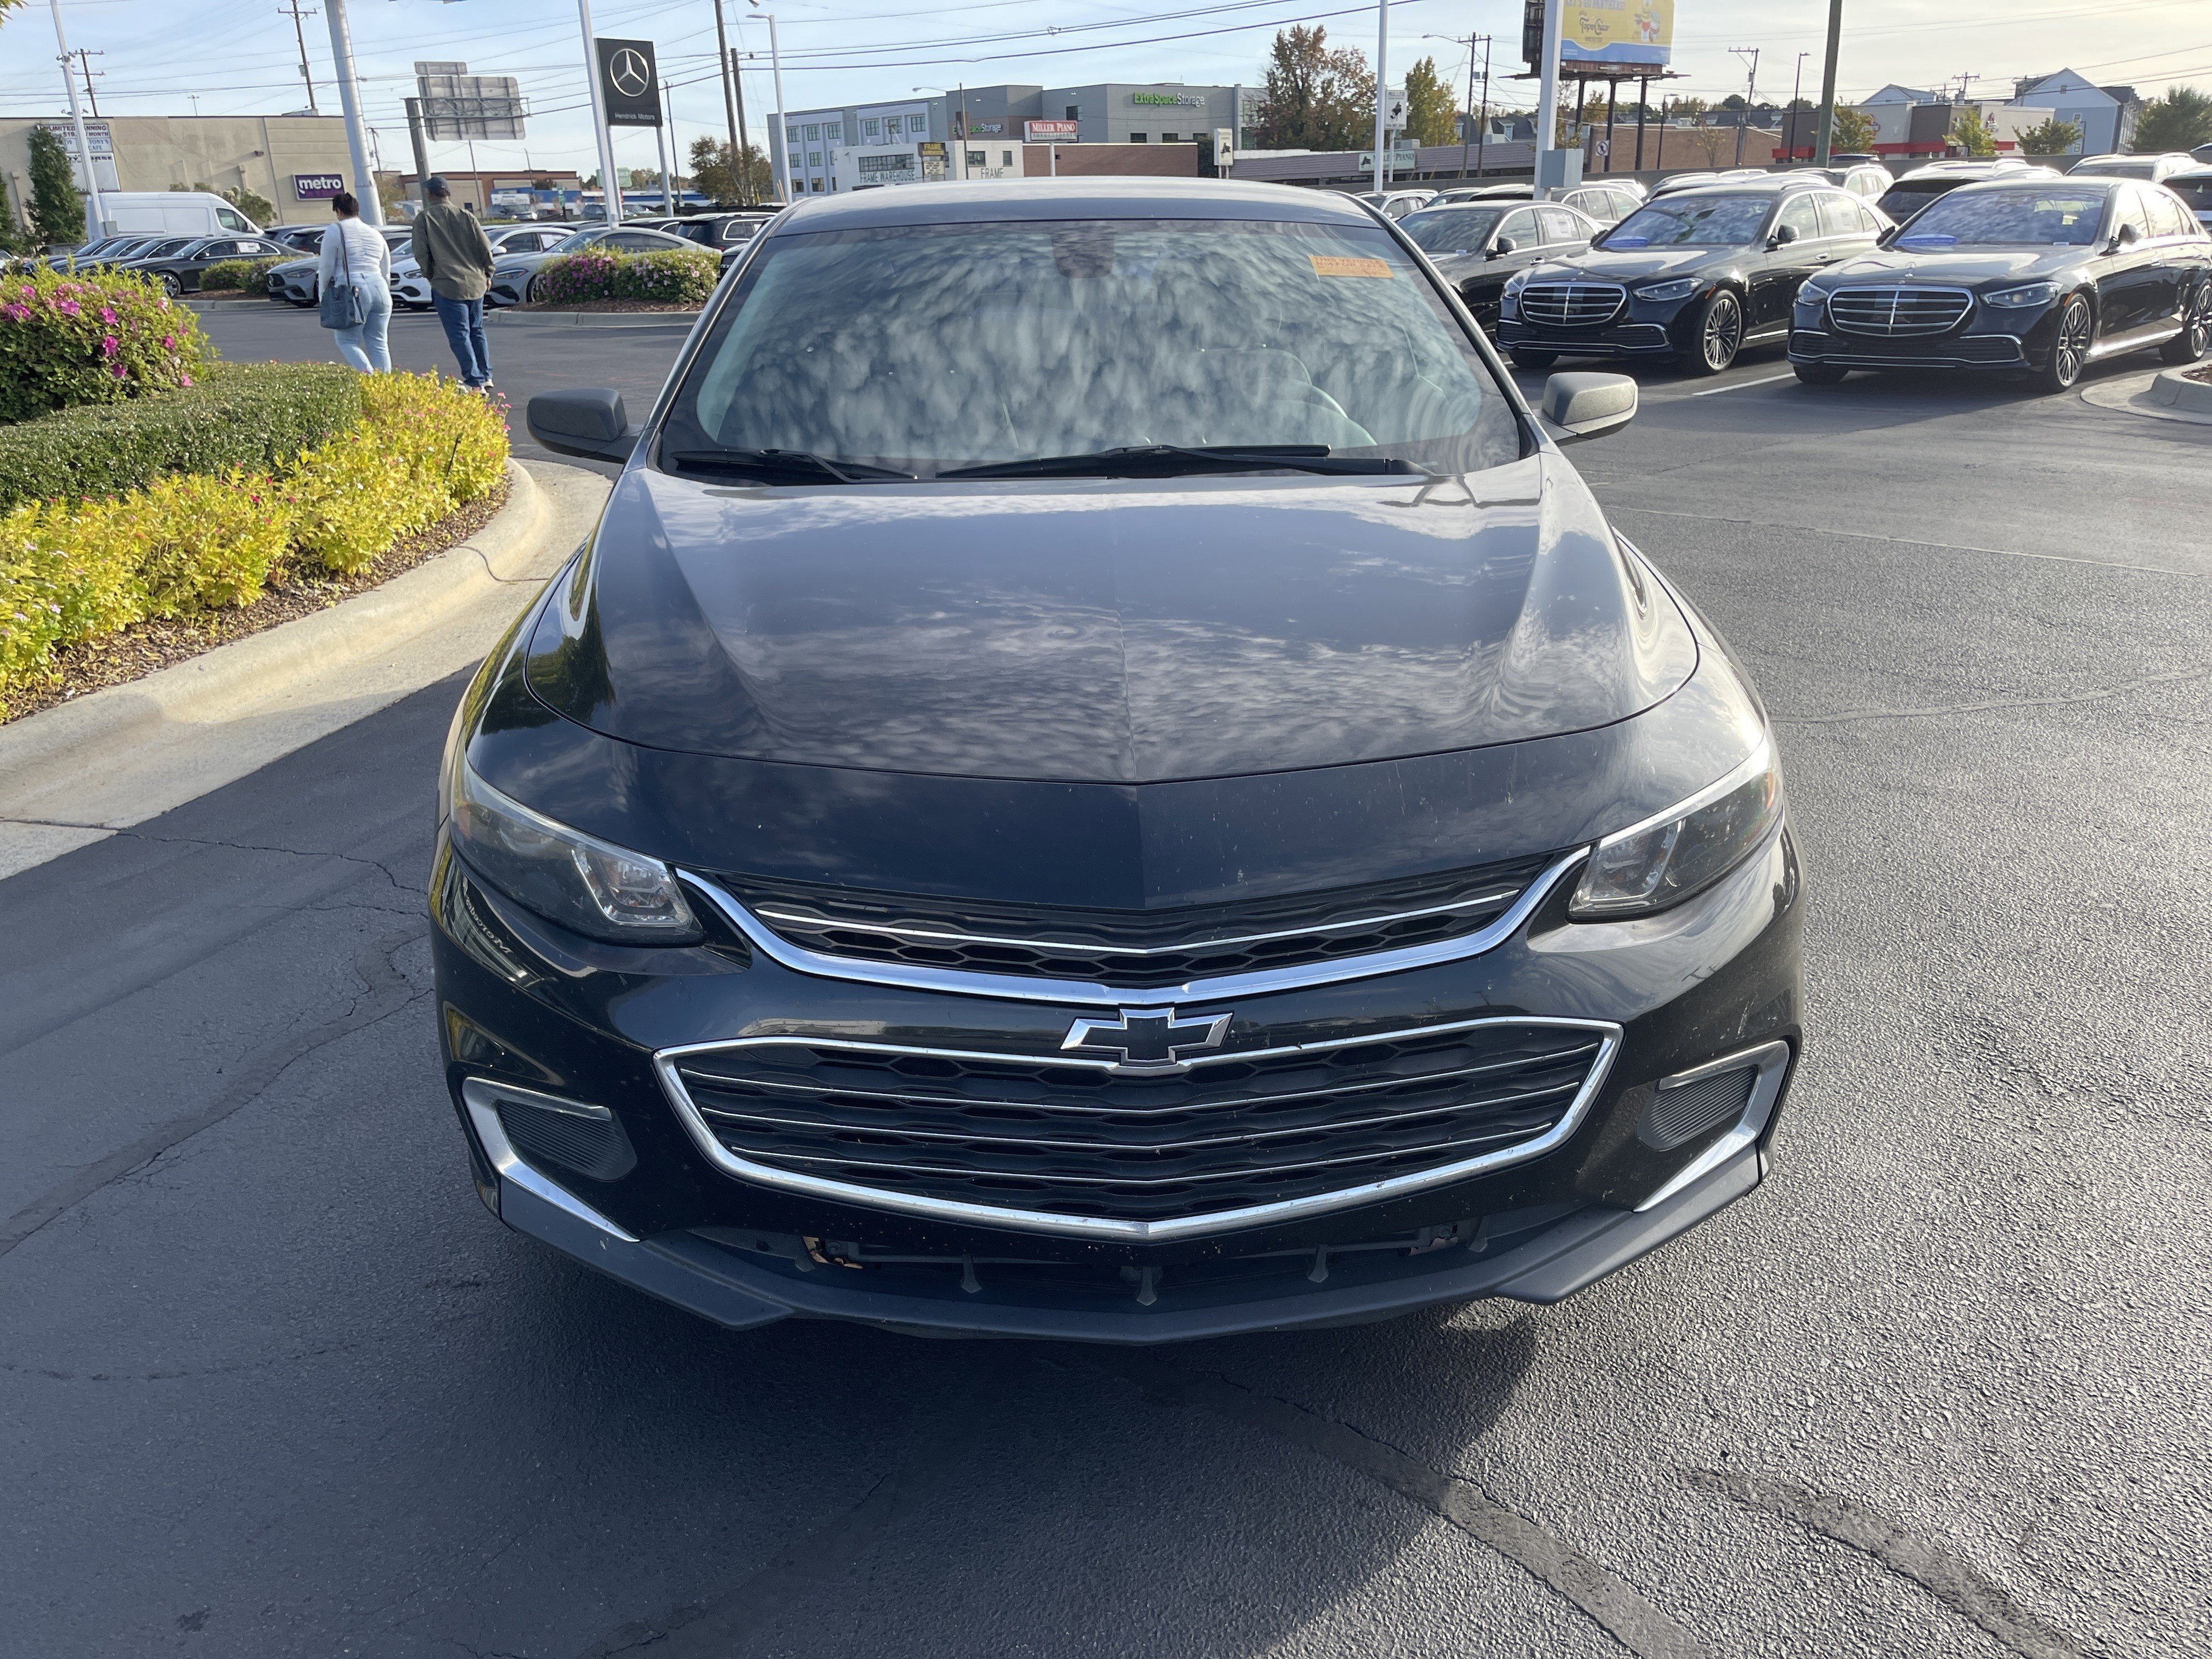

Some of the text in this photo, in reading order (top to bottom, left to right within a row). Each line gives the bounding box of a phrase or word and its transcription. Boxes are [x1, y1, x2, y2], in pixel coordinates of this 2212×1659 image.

[1133, 92, 1205, 108] ExtraSpaceStorage
[1032, 122, 1075, 132] MILLER PIANO
[1395, 153, 1414, 161] PIANO
[860, 170, 915, 183] FRAME WAREHOUSE
[980, 168, 1004, 179] FRAME
[298, 177, 342, 190] metro
